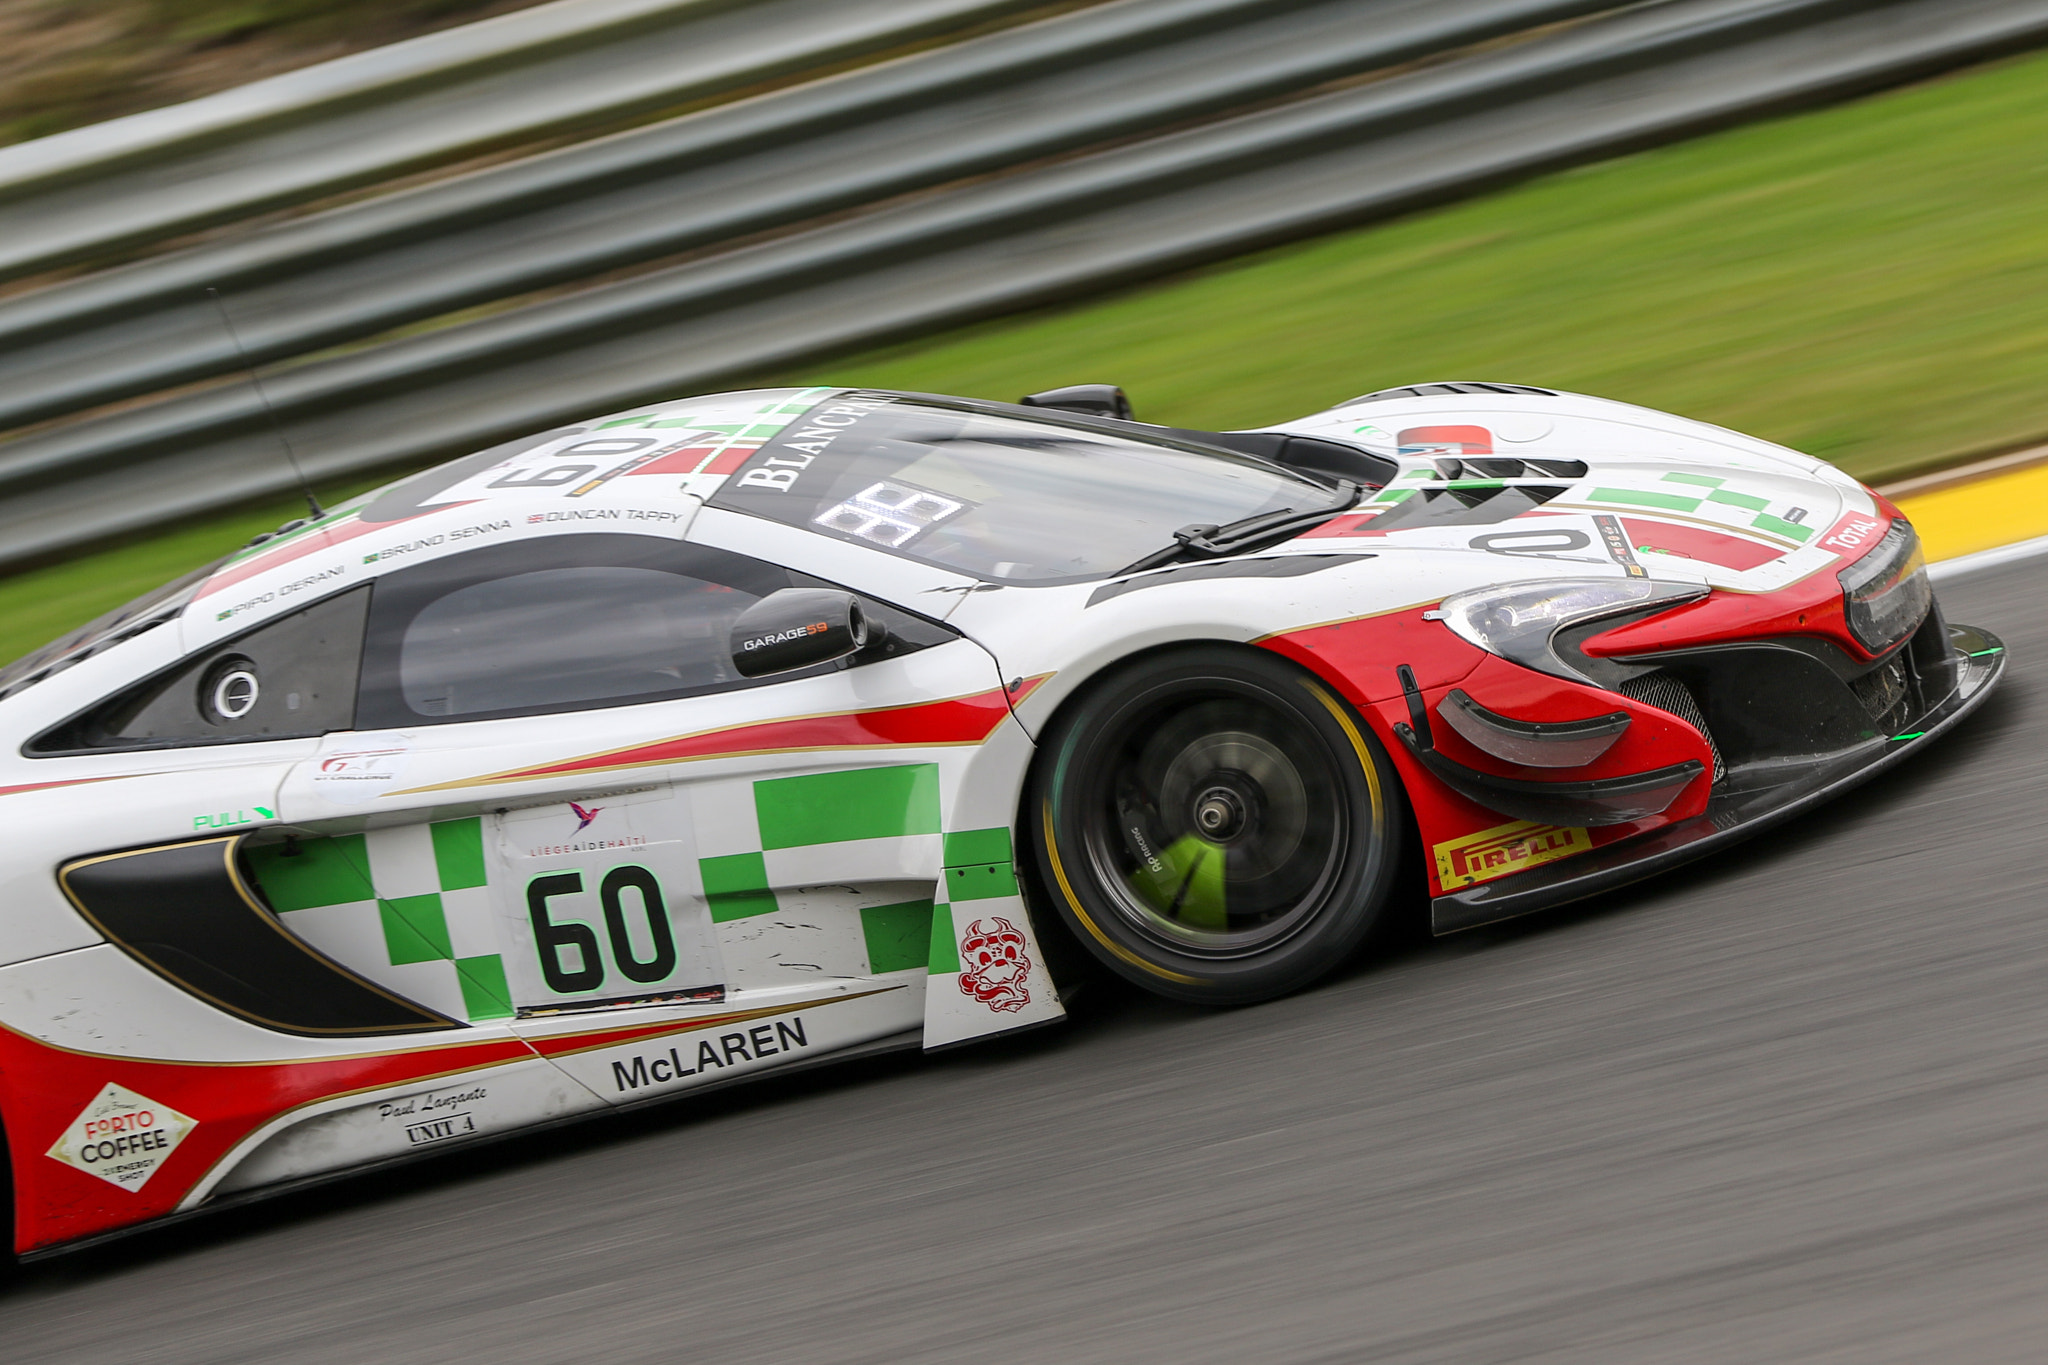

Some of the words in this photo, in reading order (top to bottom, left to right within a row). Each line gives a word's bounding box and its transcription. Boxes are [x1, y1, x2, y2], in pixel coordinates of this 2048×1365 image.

[486, 438, 659, 489] 60
[546, 509, 621, 524] DUNCAN
[626, 509, 684, 524] TAPPY
[378, 534, 444, 560] BRUNO
[449, 519, 513, 543] SENNA
[1825, 519, 1878, 549] TOTAL
[233, 592, 275, 614] PIPO
[279, 565, 345, 596] DERANI
[743, 622, 828, 651] GARAGE59
[193, 810, 252, 831] PULL
[1131, 827, 1152, 857] RACING
[1450, 822, 1574, 877] PIRELLI
[526, 863, 677, 994] 60
[611, 1017, 808, 1091] McLAREN
[378, 1103, 416, 1121] Paul
[421, 1087, 487, 1110] Lanzante
[85, 1110, 155, 1140] FORTO
[405, 1120, 453, 1143] UNIT
[463, 1116, 475, 1131] 4
[80, 1129, 169, 1164] COFFEE
